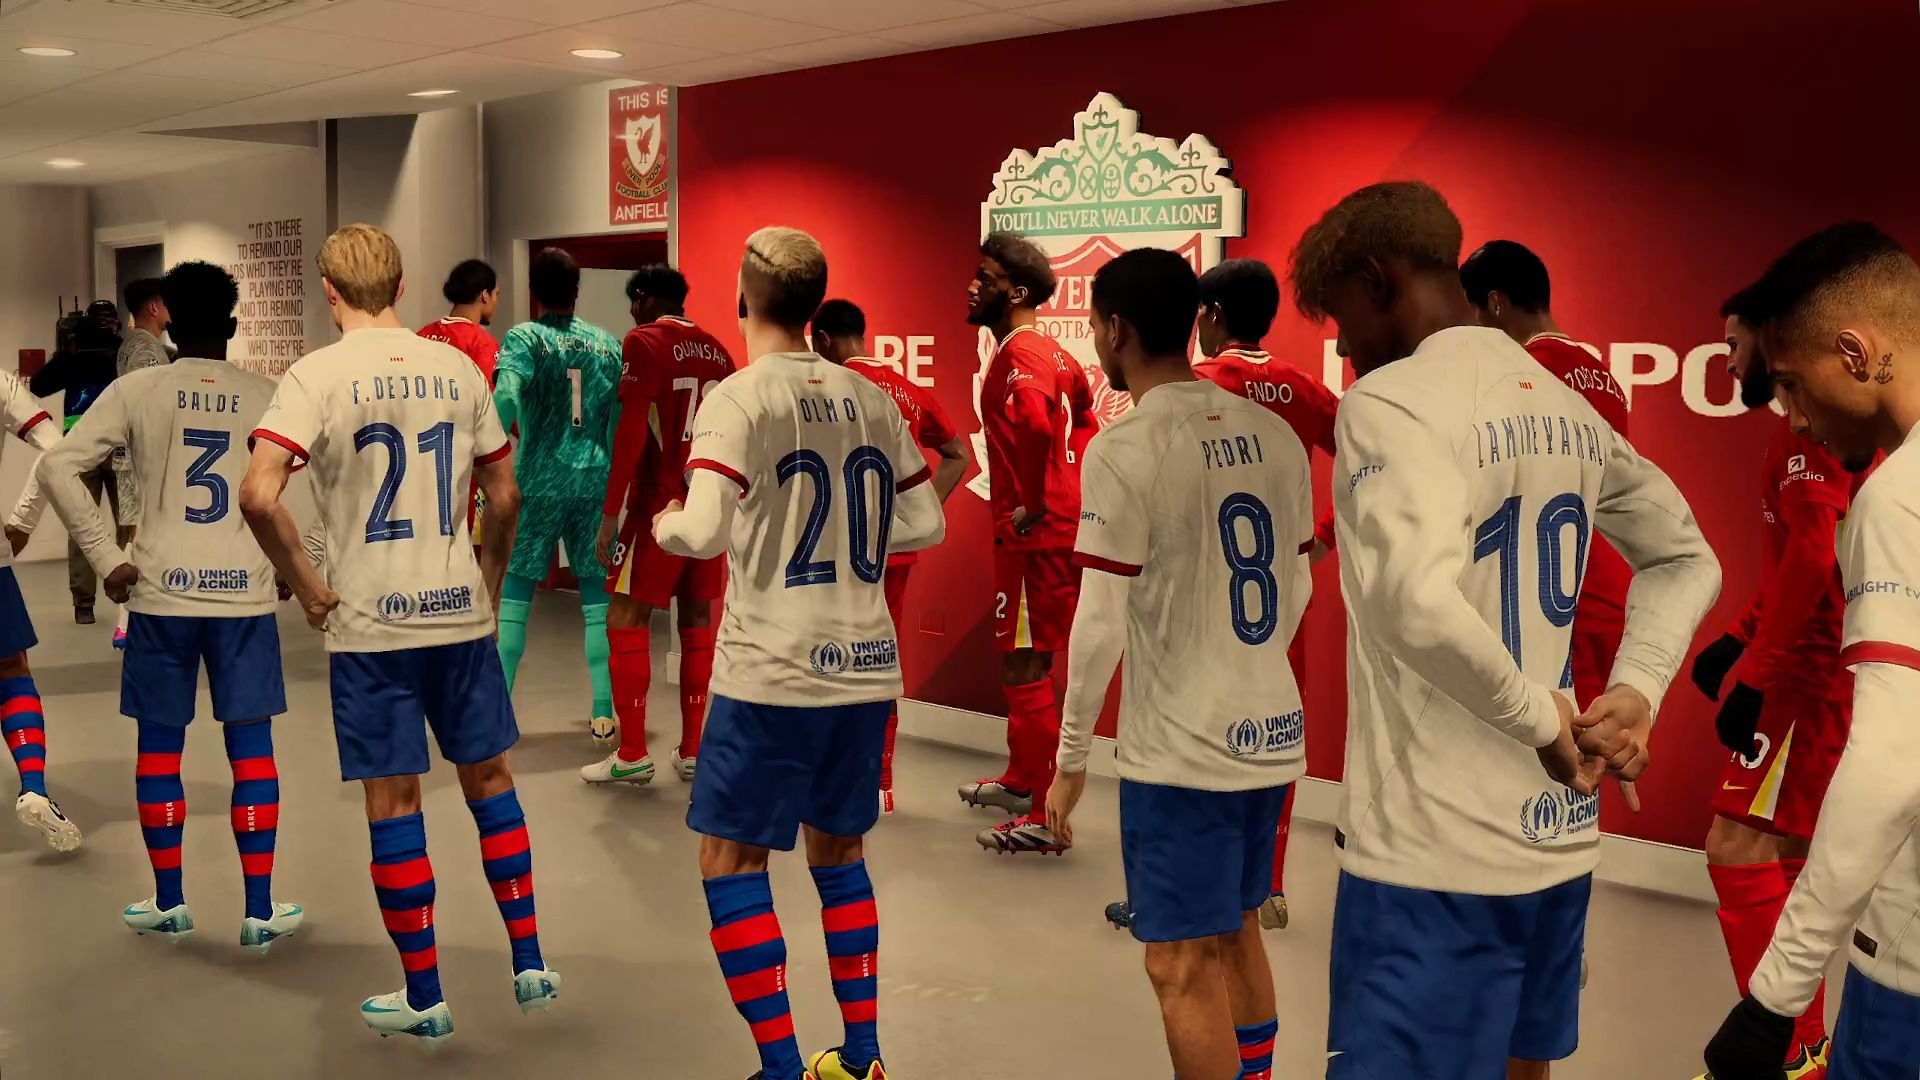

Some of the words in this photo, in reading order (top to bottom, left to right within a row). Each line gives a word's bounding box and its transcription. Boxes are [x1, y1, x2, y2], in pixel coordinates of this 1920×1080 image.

[617, 92, 650, 112] THIS
[625, 164, 642, 186] LIVER
[617, 183, 650, 198] FOOTBALL
[653, 183, 668, 195] CLU
[265, 222, 273, 238] IS
[275, 219, 302, 236] THERE
[992, 213, 1044, 232] YOU'LL
[1047, 209, 1100, 230] NEVER
[1101, 206, 1153, 227] WALK
[1156, 203, 1218, 225] ALONE
[237, 244, 247, 260] TO
[250, 241, 281, 259] REMIND
[284, 239, 302, 256] OUR
[246, 262, 265, 279] WHO
[249, 280, 283, 298] PLAYING
[240, 301, 255, 317] AND
[257, 301, 268, 317] TO
[270, 299, 303, 316] REMIND
[239, 321, 252, 336] THE
[254, 320, 304, 336] OPPOSITION
[248, 340, 267, 356] WHO
[269, 340, 304, 357] THEY'RE
[673, 340, 727, 370] QUANSAH
[177, 390, 240, 414] BALDE
[566, 368, 582, 427] 1
[1245, 381, 1293, 403] ENDO
[799, 397, 857, 424] OLMO
[1201, 434, 1263, 470] PEDRI
[183, 428, 230, 524] 3
[353, 421, 455, 544] 21
[776, 445, 894, 589] 20
[612, 541, 626, 566] 8
[198, 569, 248, 580] UNHCR
[1218, 492, 1278, 646] 8
[198, 580, 248, 589] ACNUR
[418, 585, 470, 602] UNHCR
[419, 596, 471, 614] ACNUR
[995, 591, 1007, 619] 2
